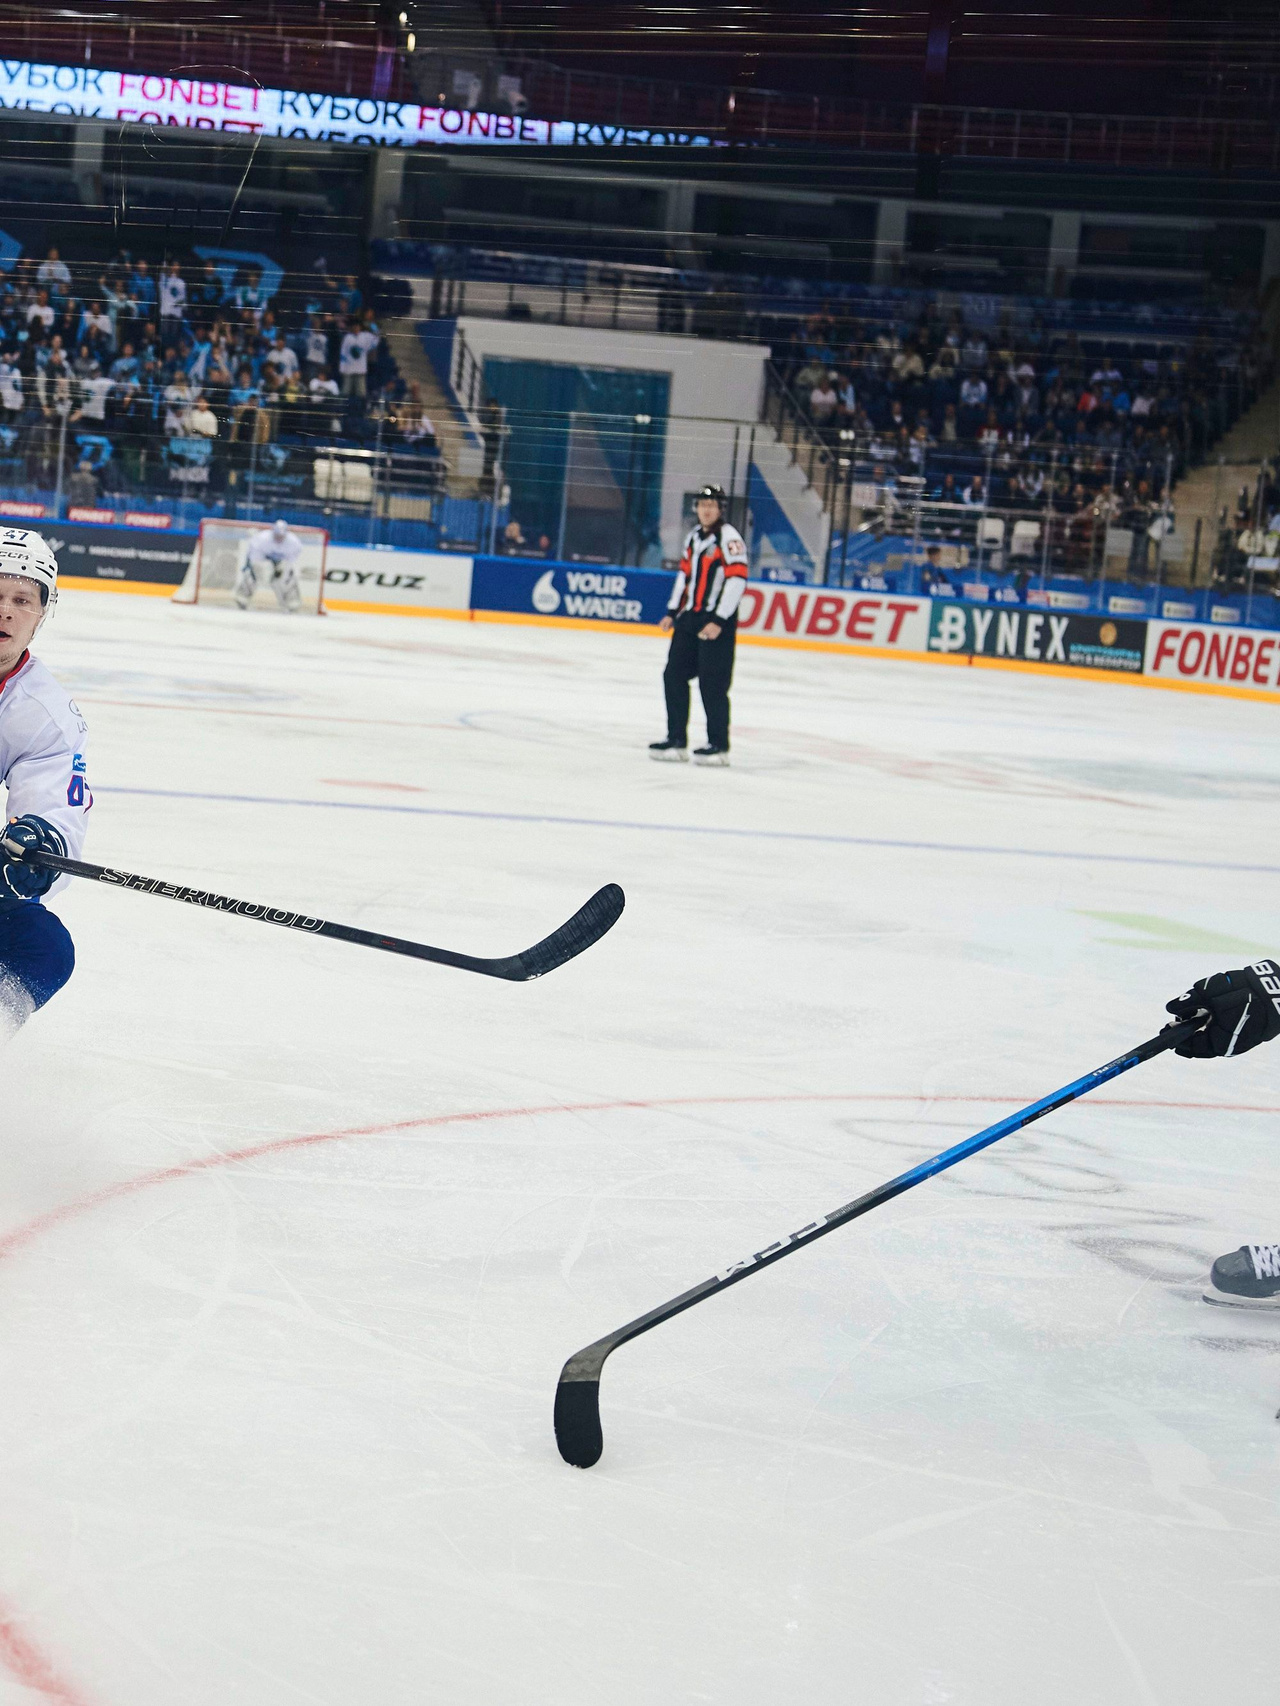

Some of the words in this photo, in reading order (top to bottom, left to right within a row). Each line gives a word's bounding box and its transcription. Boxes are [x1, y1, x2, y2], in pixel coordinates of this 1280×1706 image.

[118, 73, 262, 111] FONBET
[278, 90, 406, 127] КУБОК
[417, 105, 563, 144] FONBET
[3, 529, 29, 541] 47
[566, 571, 628, 597] YOUR
[563, 594, 643, 622] WATER
[738, 588, 919, 643] ONBET
[929, 605, 1069, 662] BYNEX
[1152, 628, 1280, 687] FONBE
[98, 866, 326, 933] SHERWOOD
